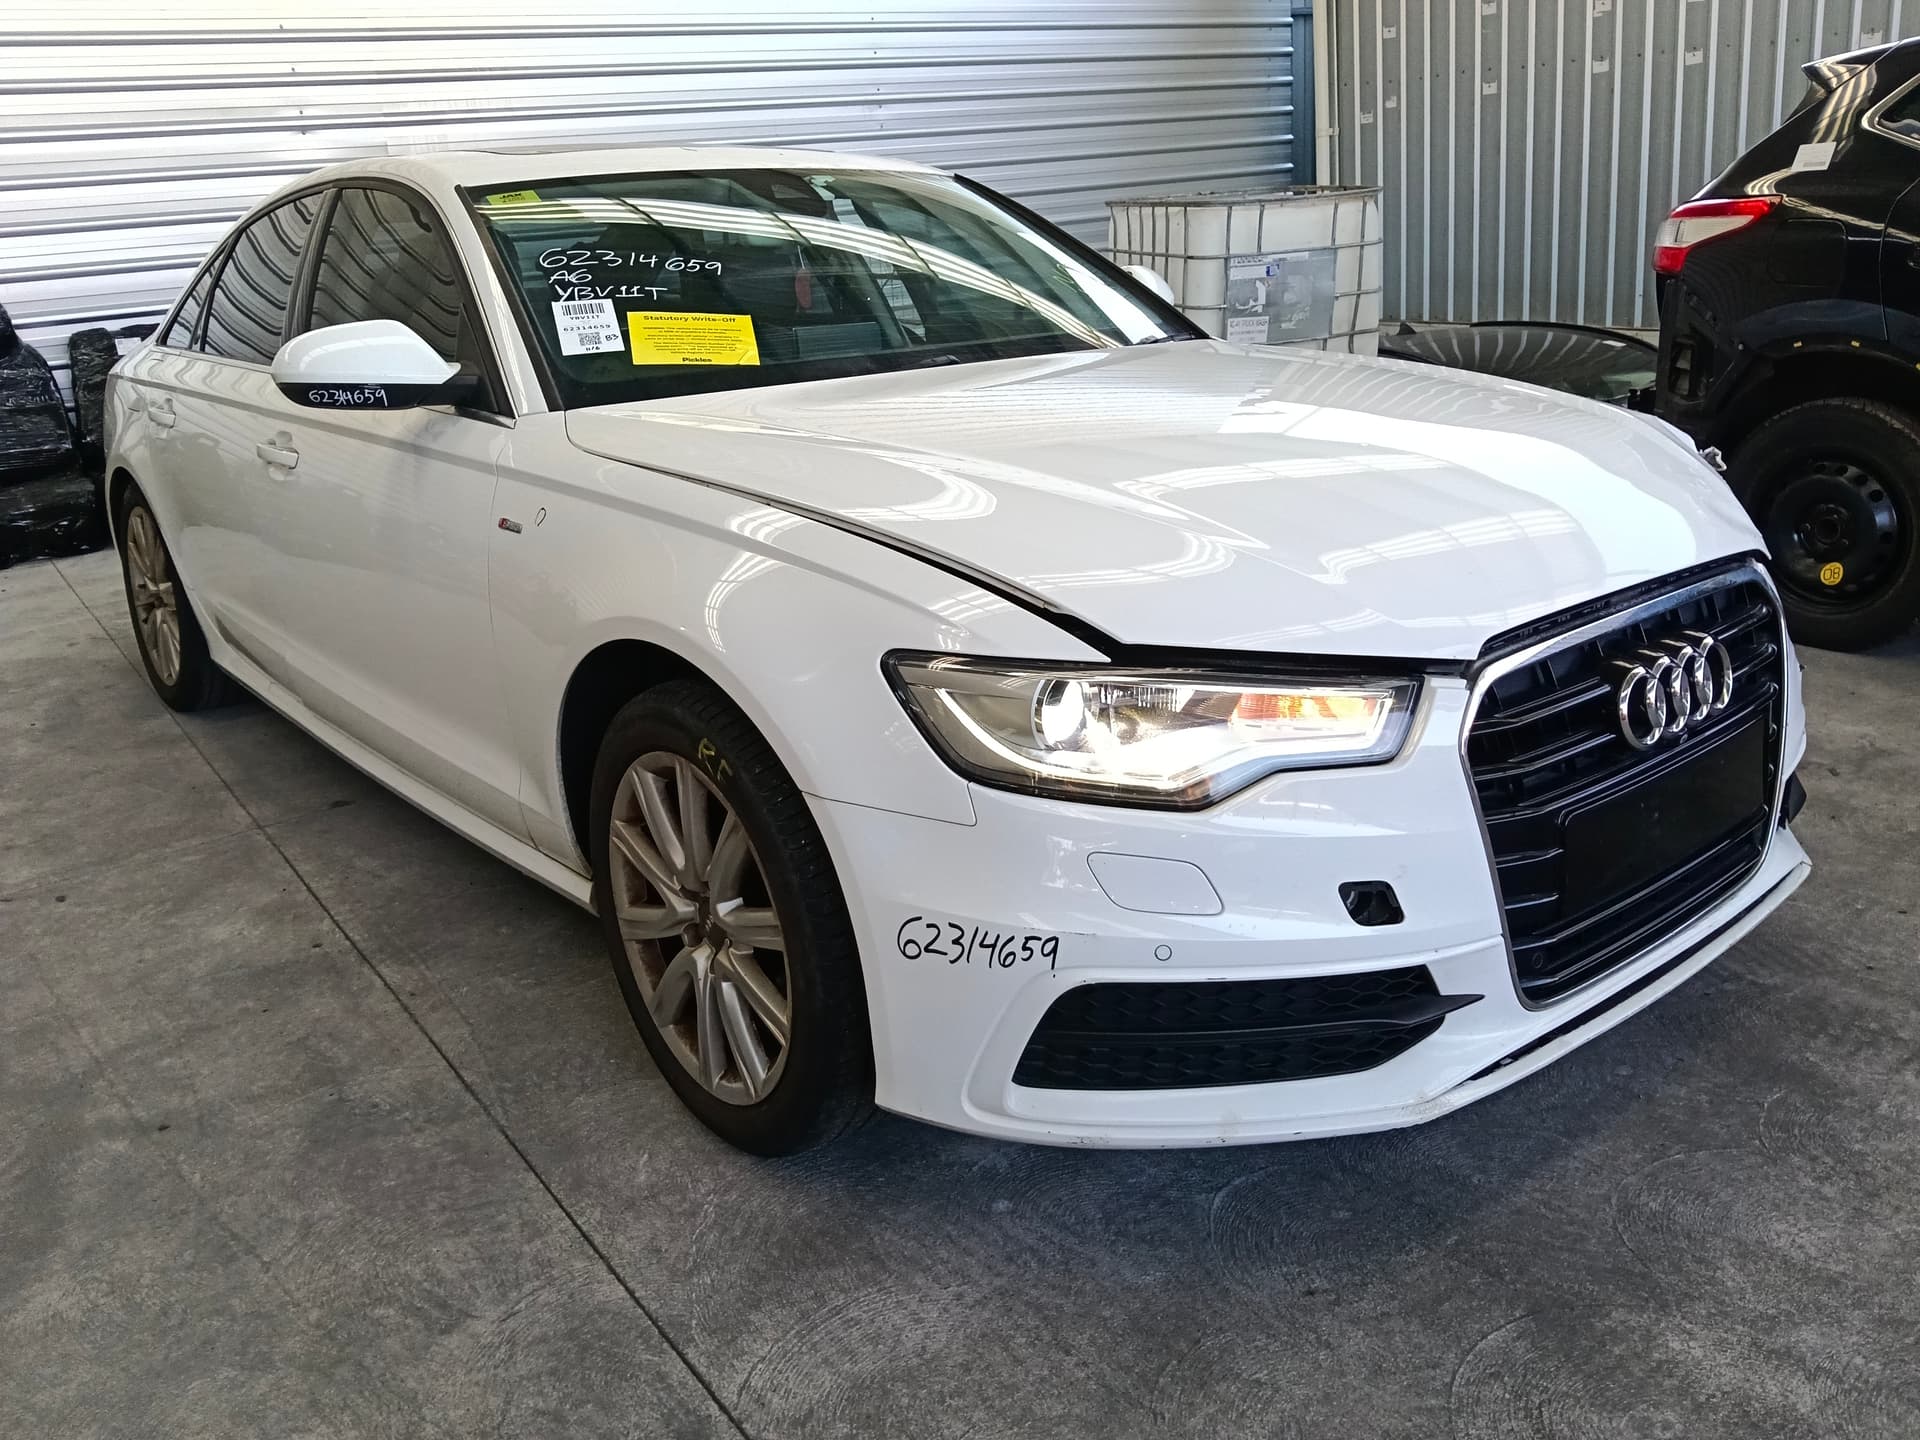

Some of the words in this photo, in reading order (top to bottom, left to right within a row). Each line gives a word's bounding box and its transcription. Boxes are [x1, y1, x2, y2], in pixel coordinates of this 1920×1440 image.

[539, 248, 722, 275] 62314659
[549, 269, 592, 284] A6
[563, 324, 611, 332] 62314659
[308, 389, 388, 407] 62314659
[897, 916, 1059, 970] 62314659
